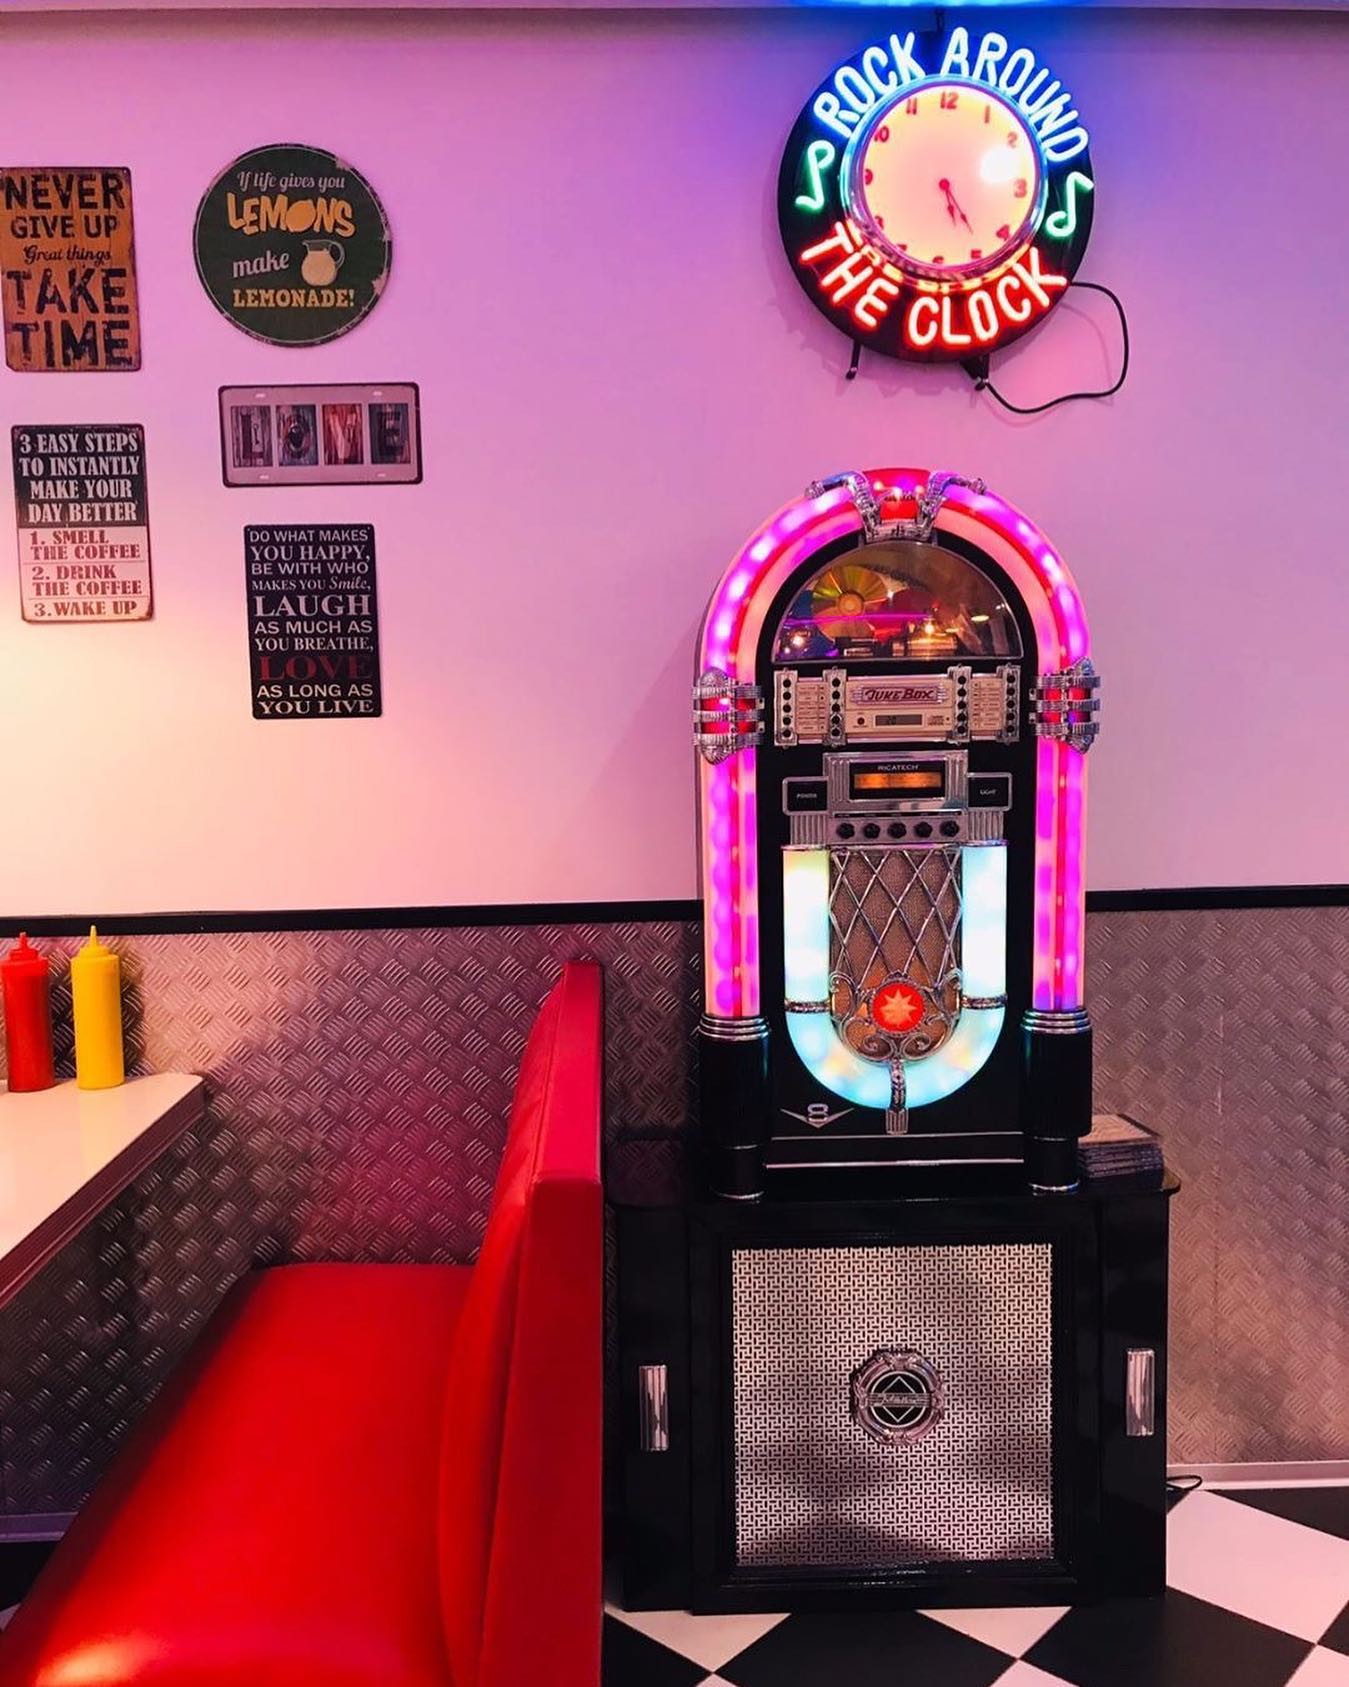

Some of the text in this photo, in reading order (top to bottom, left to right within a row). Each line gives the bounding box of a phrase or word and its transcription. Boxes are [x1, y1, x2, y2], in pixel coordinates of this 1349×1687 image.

[813, 27, 1089, 162] ROCK AROUND
[940, 91, 958, 110] 12
[906, 97, 918, 115] 11
[984, 105, 991, 124] 1
[1007, 132, 1019, 148] 2
[5, 173, 125, 210] NEVER
[237, 171, 345, 193] If life gives you
[1014, 179, 1026, 198] 3
[227, 192, 355, 237] LEMONS
[11, 215, 118, 239] GIVE UP
[24, 245, 111, 267] Great things
[232, 251, 290, 278] make
[7, 268, 129, 315] TAKE
[801, 221, 1067, 345] THE CLOCK
[233, 289, 355, 308] LEMONADE!
[12, 320, 132, 368] TIME
[20, 432, 138, 454] 3 EASY STEPS
[19, 456, 140, 476] TO INSTANTLY
[30, 479, 132, 499] MAKE YOUR
[28, 502, 137, 523] DAY BETTER
[30, 530, 109, 545] 1. SMELL
[250, 529, 368, 542] DO WHAT MAKES
[30, 545, 140, 560] THE COFFEE
[250, 544, 370, 561] YOU HAPPY,
[32, 565, 116, 580] 2. DRINK
[251, 562, 368, 575] BE WITH WHO
[32, 581, 142, 596] THE COFFEE
[252, 576, 371, 591] MAKES YOU Smile,
[54, 601, 106, 616] WAKE
[113, 600, 137, 615] UP
[254, 594, 371, 617] LAUGH
[254, 620, 373, 634] AS MUCH AS
[254, 637, 374, 651] YOU BREATHE,
[259, 656, 373, 681] LOVE
[257, 684, 373, 698] AS LONG AS
[259, 700, 374, 715] YOU LIVE
